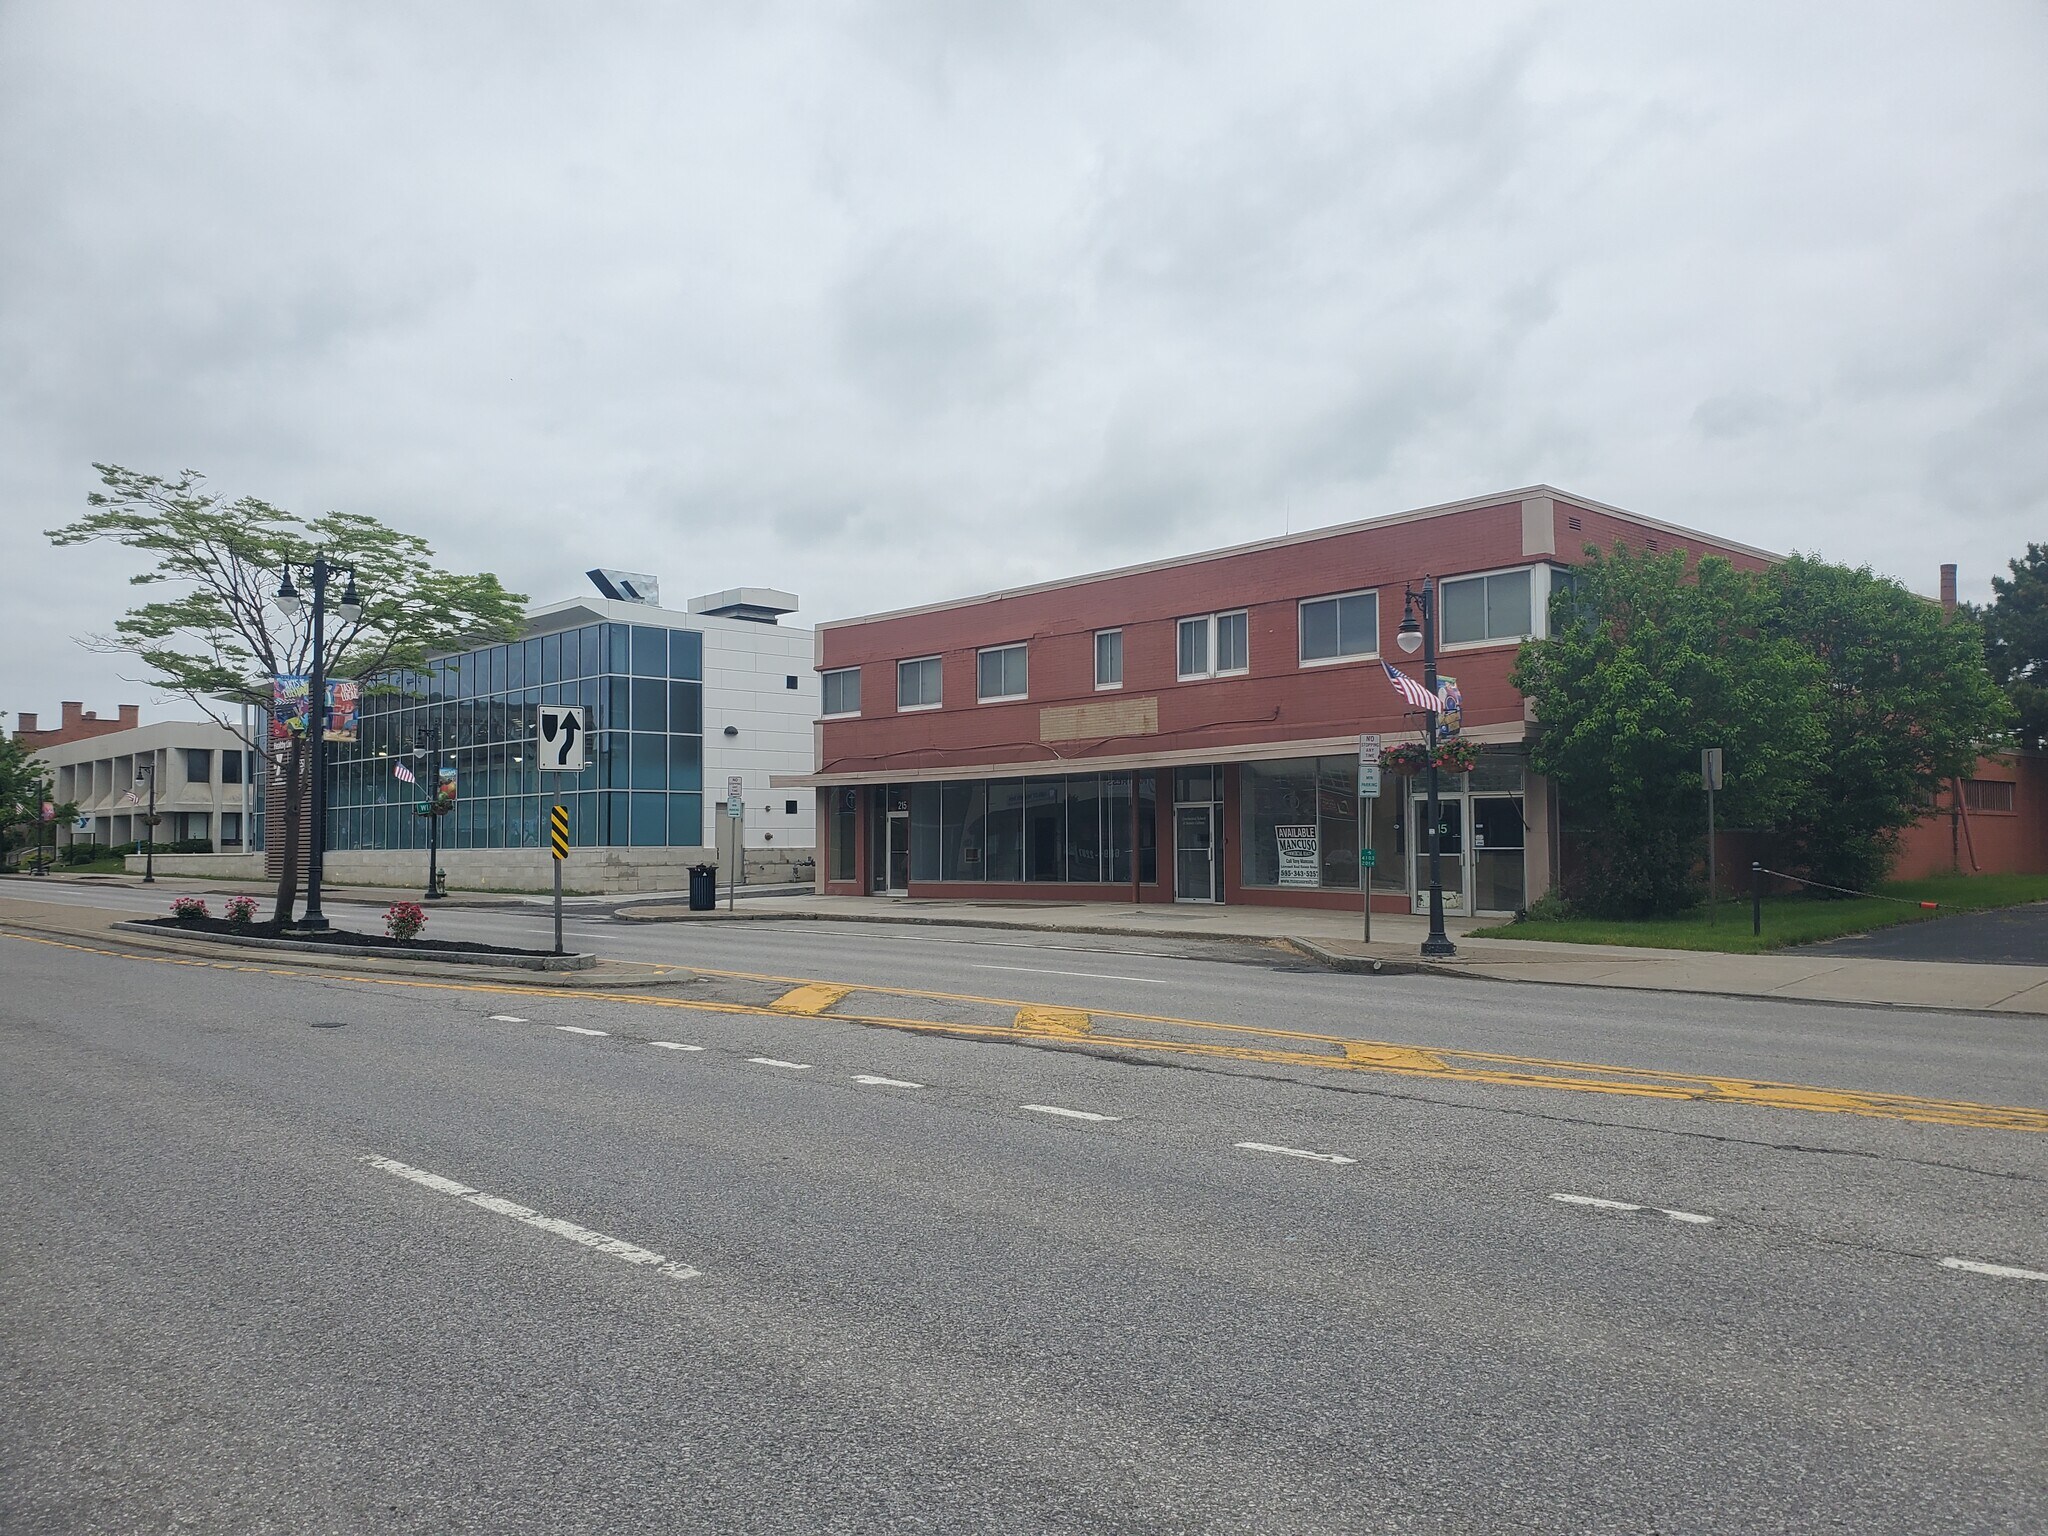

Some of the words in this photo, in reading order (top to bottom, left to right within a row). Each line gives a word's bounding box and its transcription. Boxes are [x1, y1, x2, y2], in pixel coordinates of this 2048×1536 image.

[898, 801, 907, 810] 215
[1279, 827, 1314, 838] AVAILABLE
[1278, 839, 1317, 851] MANCUSO
